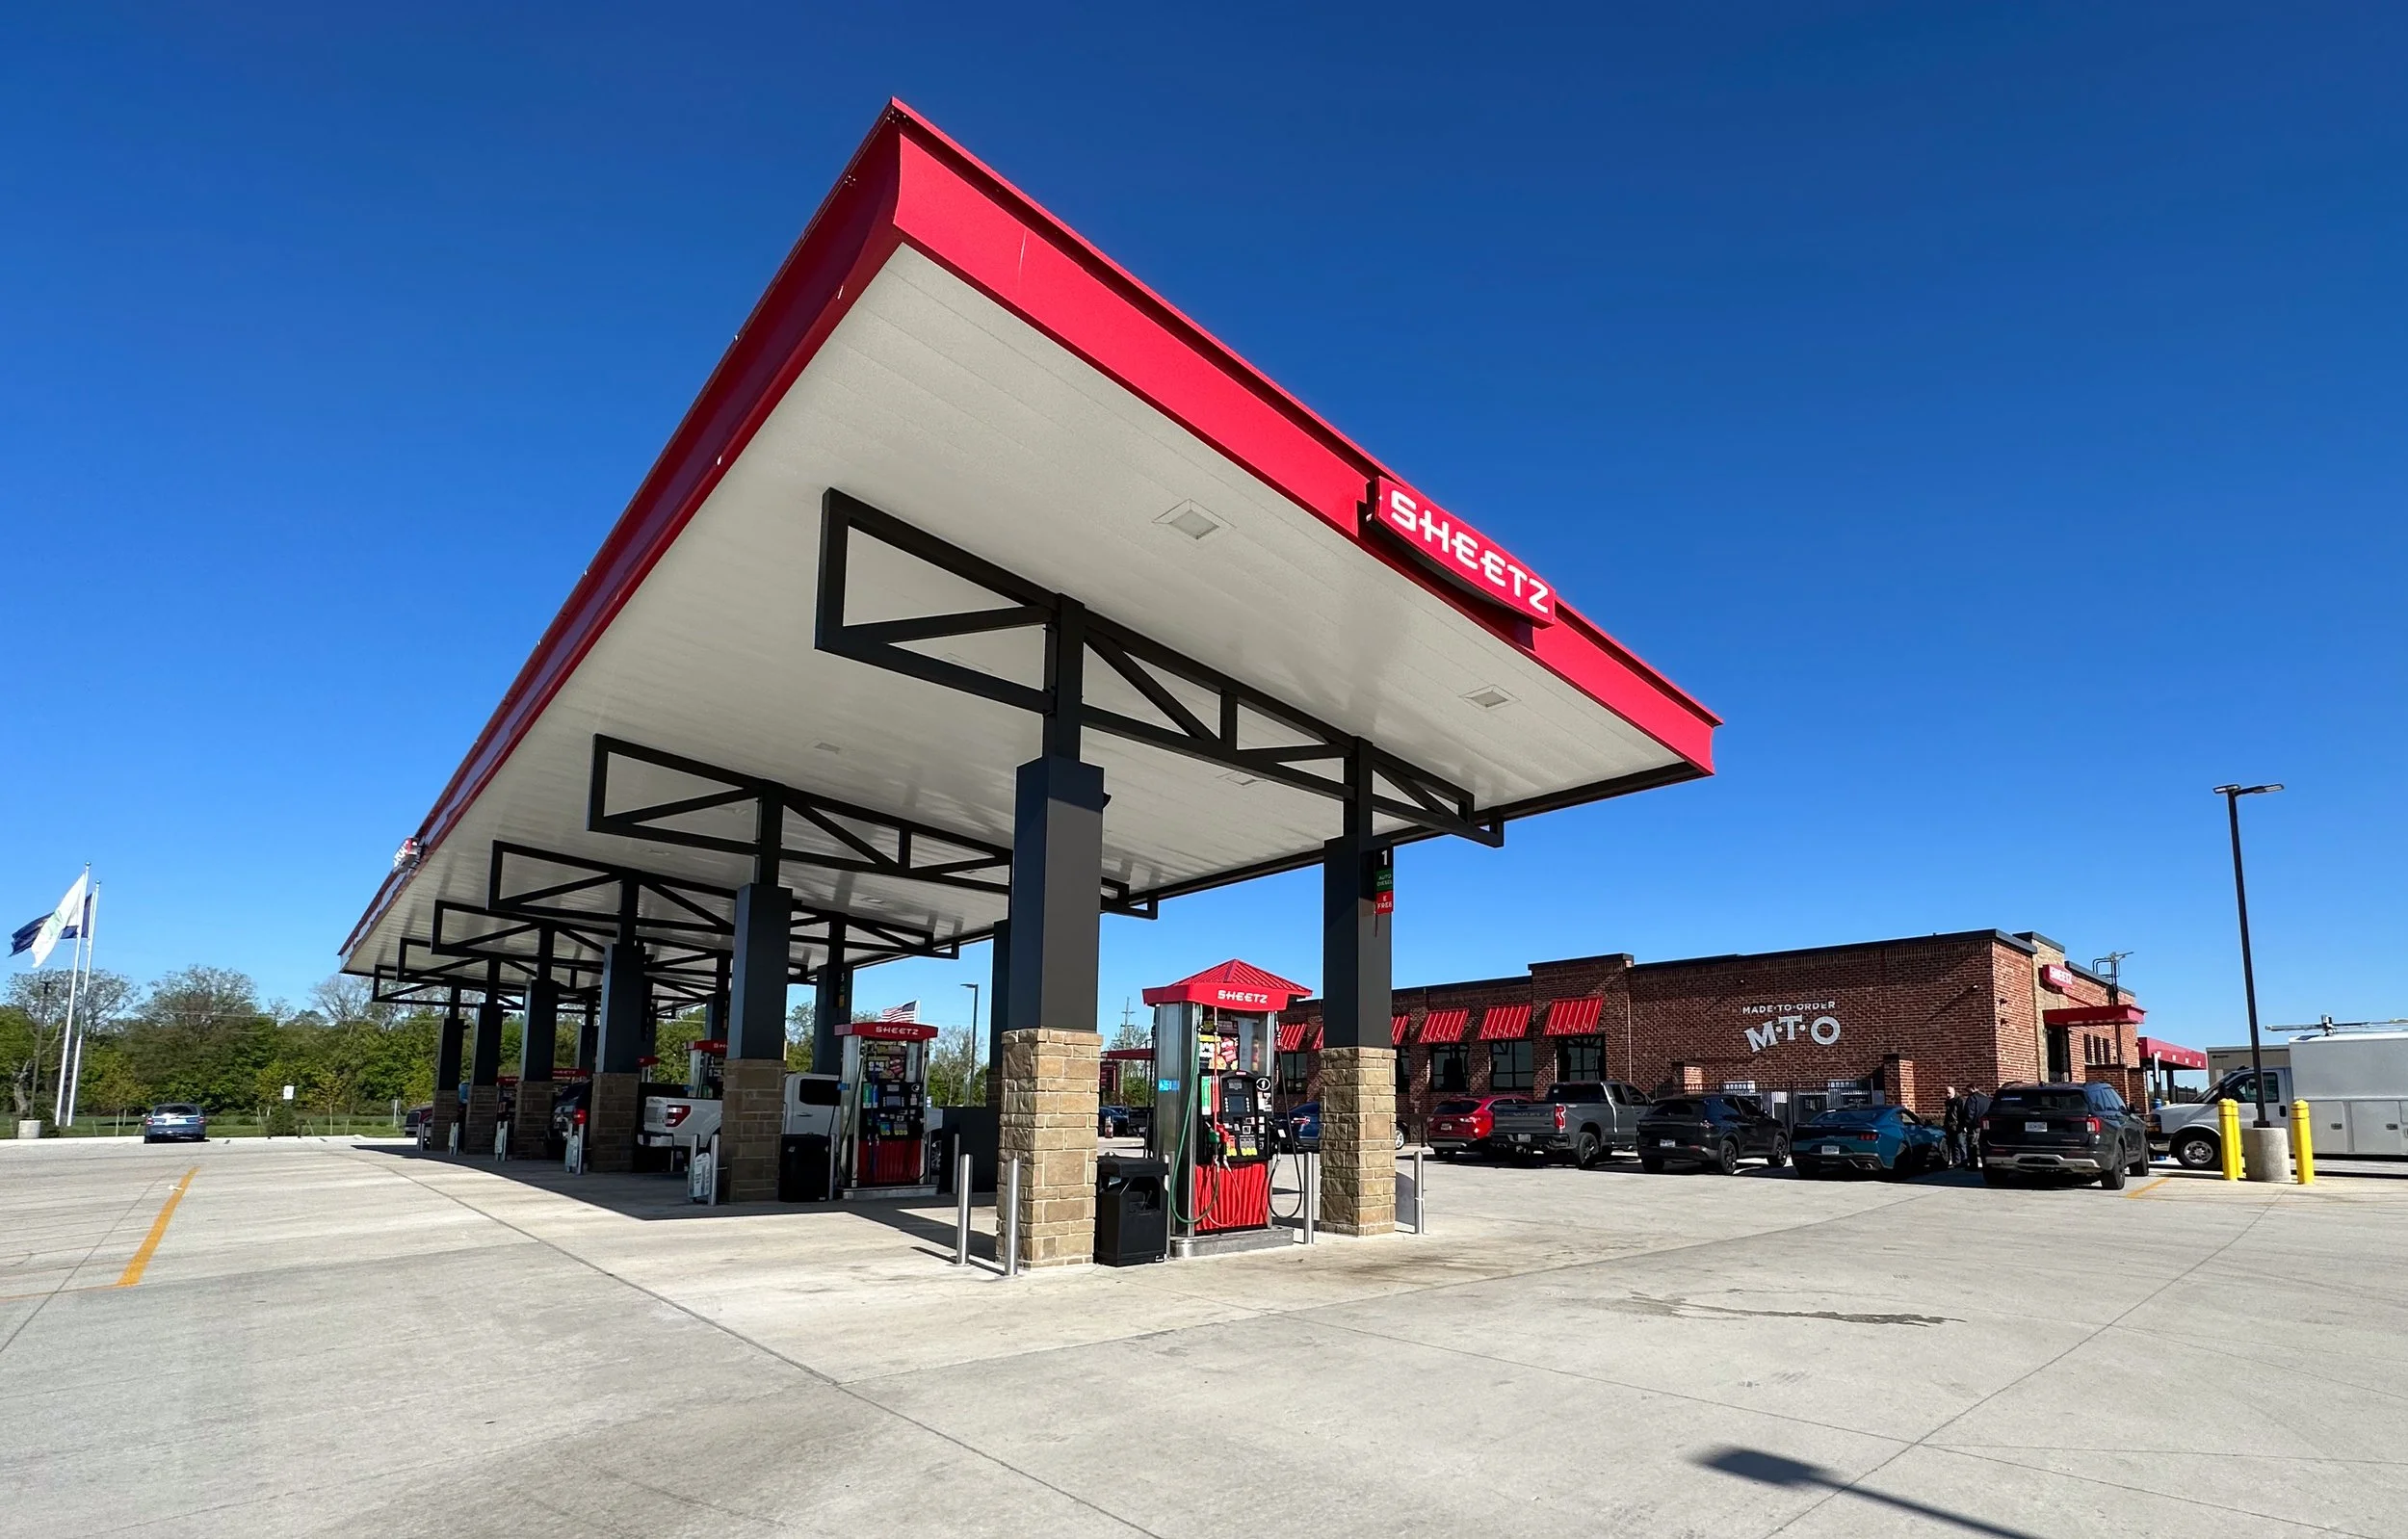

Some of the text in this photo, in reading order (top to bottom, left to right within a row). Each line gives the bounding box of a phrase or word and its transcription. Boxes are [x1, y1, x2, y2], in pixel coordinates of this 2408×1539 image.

[1390, 489, 1549, 613] SHEETZ
[1381, 849, 1388, 866] 1
[1217, 989, 1268, 1004] SHEETZ
[875, 1026, 919, 1035] SHEETZ
